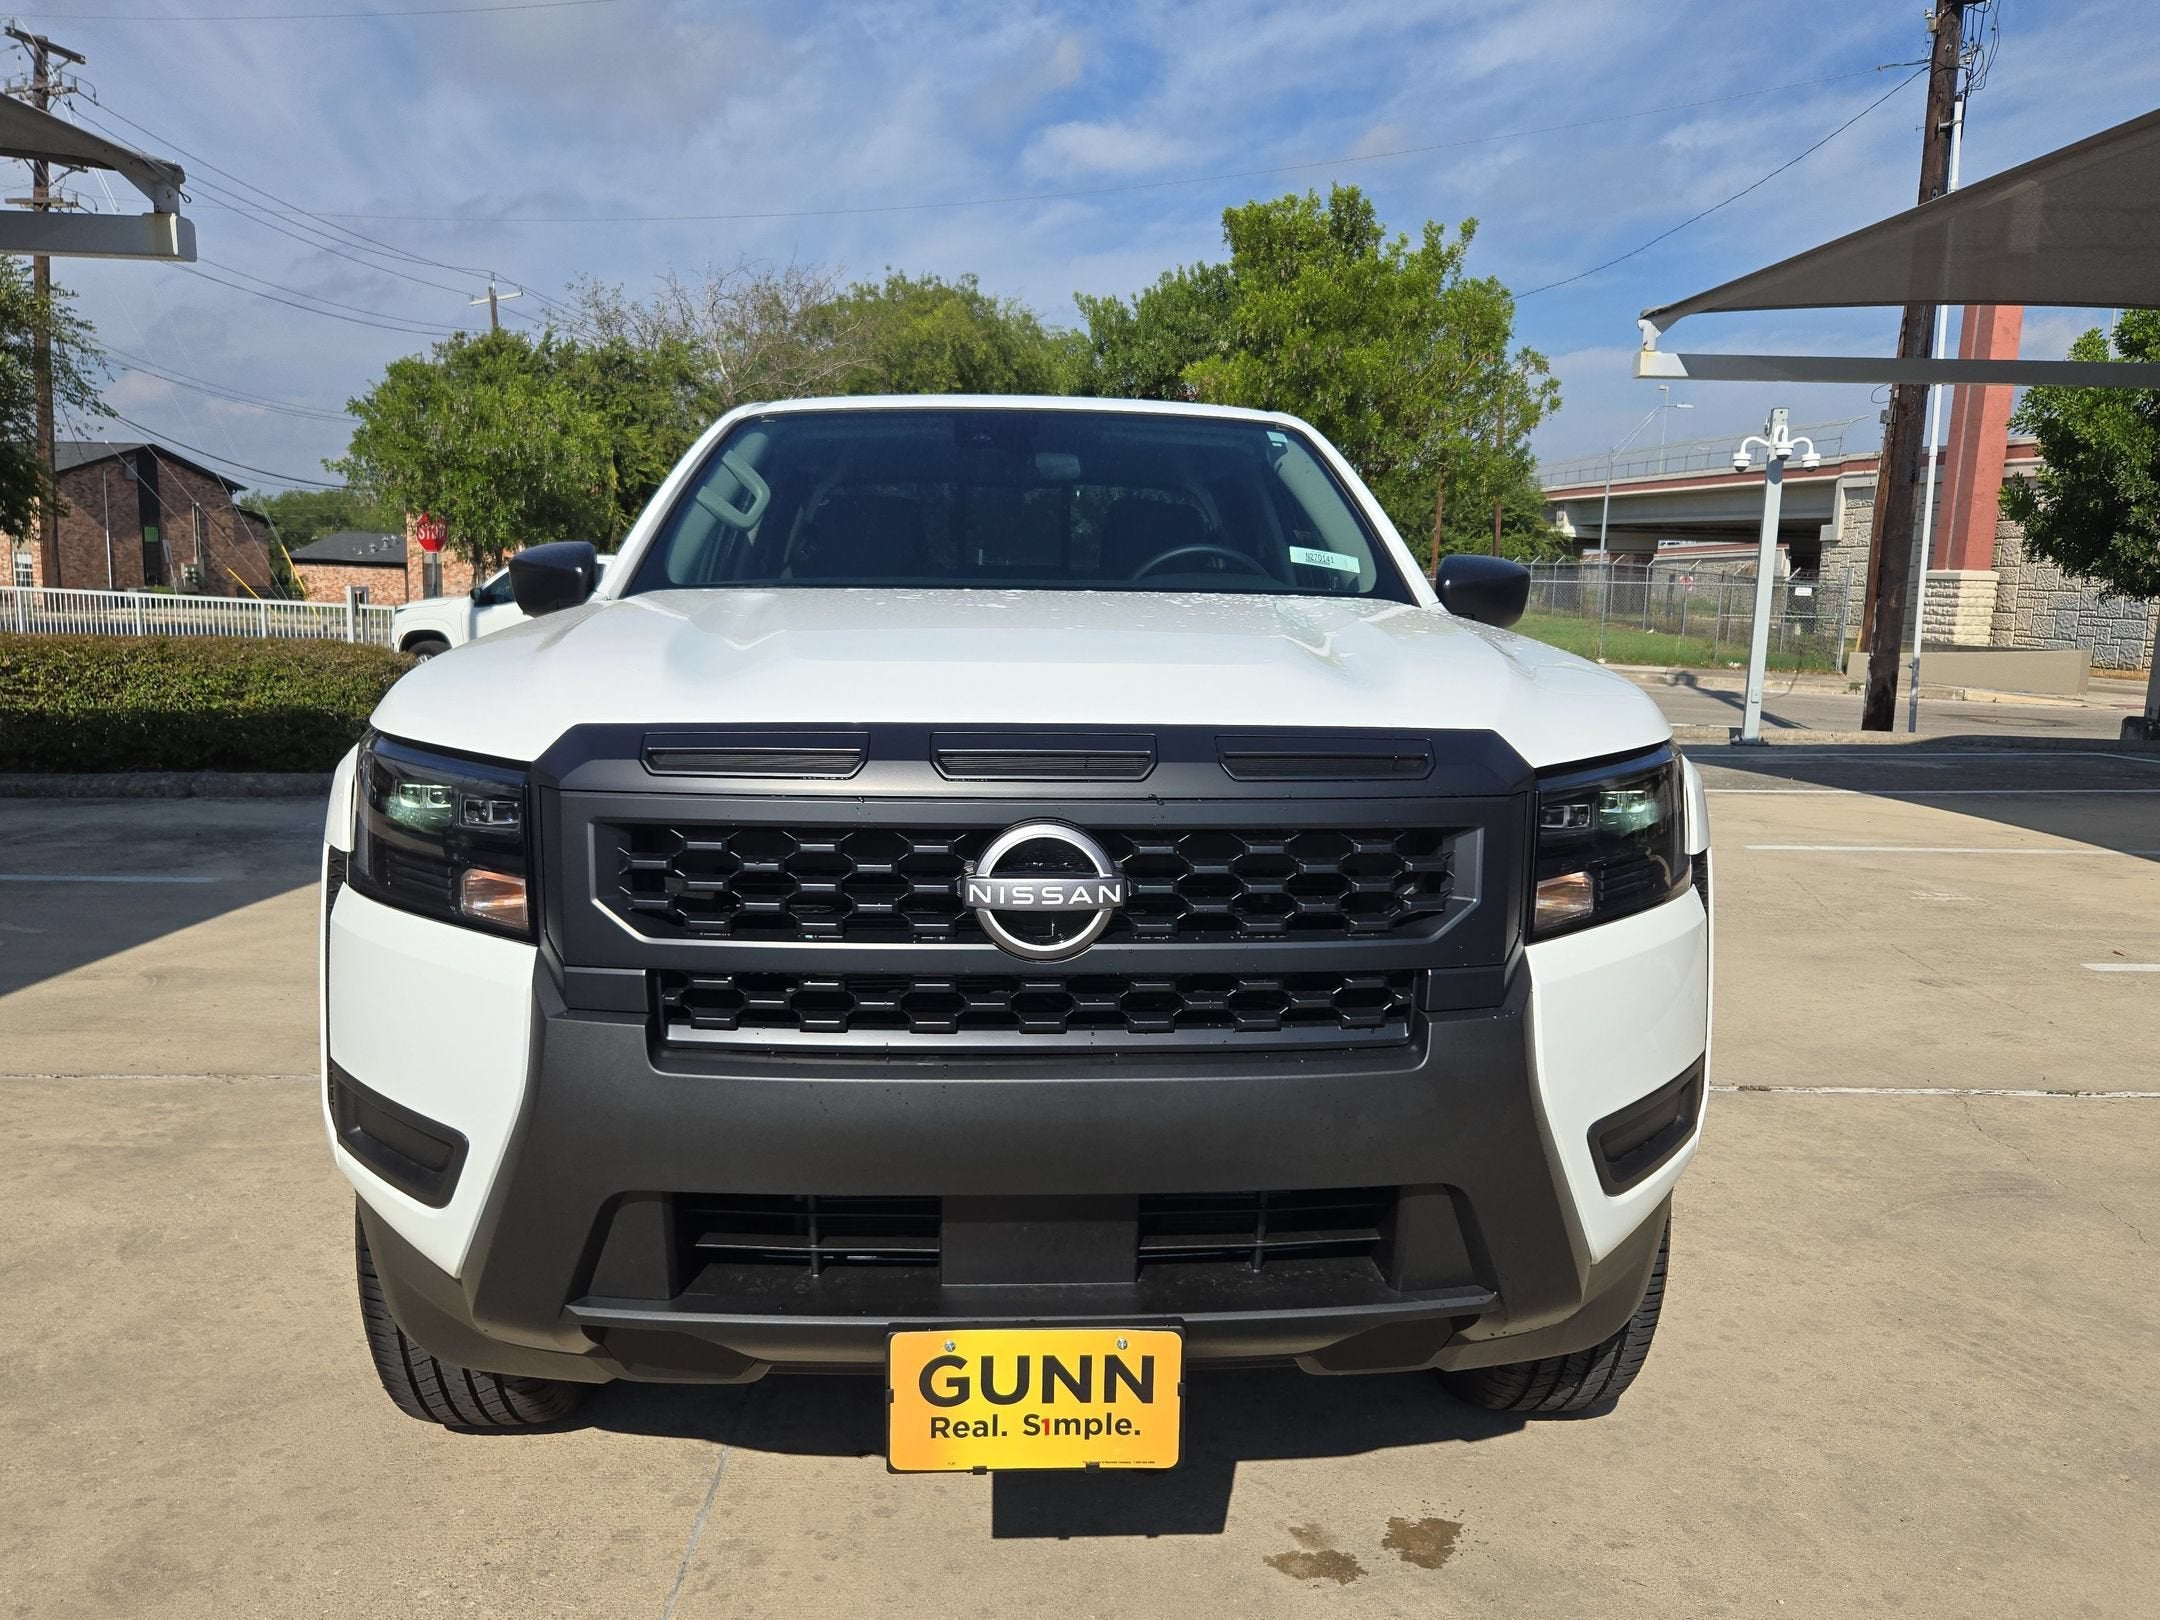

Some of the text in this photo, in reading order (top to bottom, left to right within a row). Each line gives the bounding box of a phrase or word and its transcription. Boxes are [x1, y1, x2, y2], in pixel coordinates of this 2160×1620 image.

[418, 523, 446, 540] STOP
[1305, 551, 1335, 564] N270141
[968, 883, 1121, 905] NISSAN
[918, 1354, 1155, 1407] GUNN
[930, 1412, 1142, 1440] Real. S1mple.
